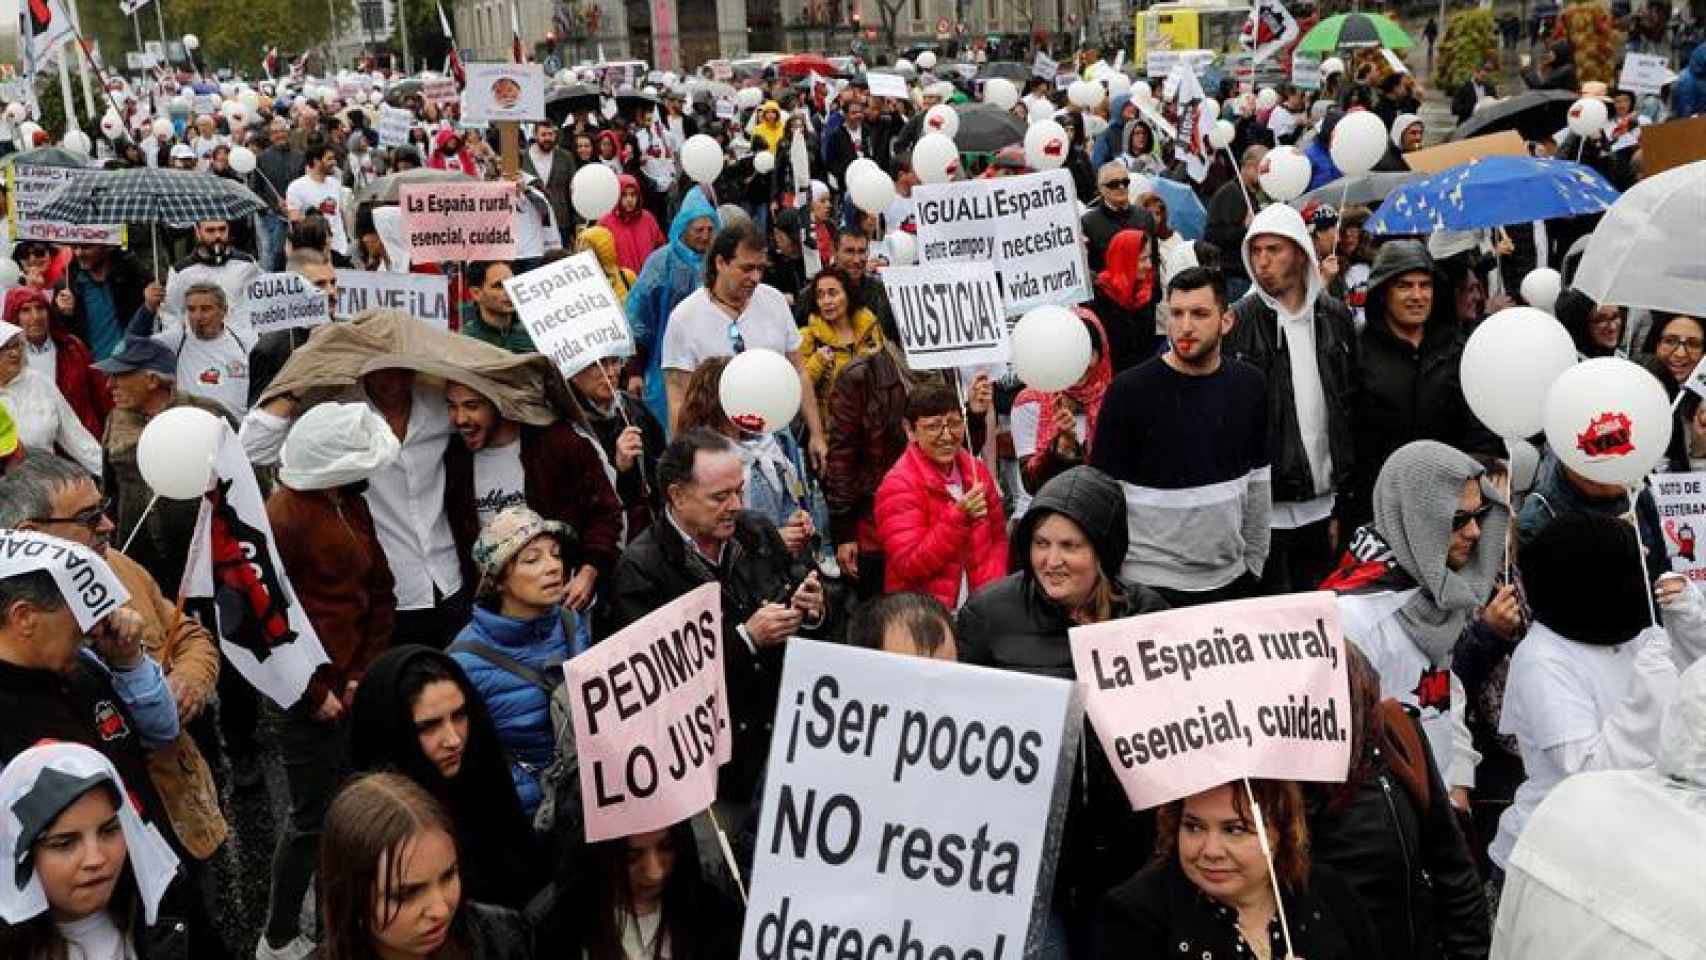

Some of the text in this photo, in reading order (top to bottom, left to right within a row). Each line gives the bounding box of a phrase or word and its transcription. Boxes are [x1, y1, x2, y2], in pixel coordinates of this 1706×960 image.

[407, 193, 513, 216] La España rural,
[993, 180, 1067, 219] España
[411, 226, 514, 248] esencial, cuidad.
[1002, 223, 1074, 259] necesita
[511, 263, 594, 305] España
[1008, 260, 1082, 300] vida rural.
[582, 610, 716, 735] PEDIMOS
[1092, 617, 1338, 690] La España rural,
[786, 674, 1042, 784] ¡Ser pocos
[1114, 694, 1347, 769] esencial, cuidad.
[594, 744, 659, 808] LO
[771, 784, 1020, 895] NO resta
[756, 896, 1006, 960] derech
